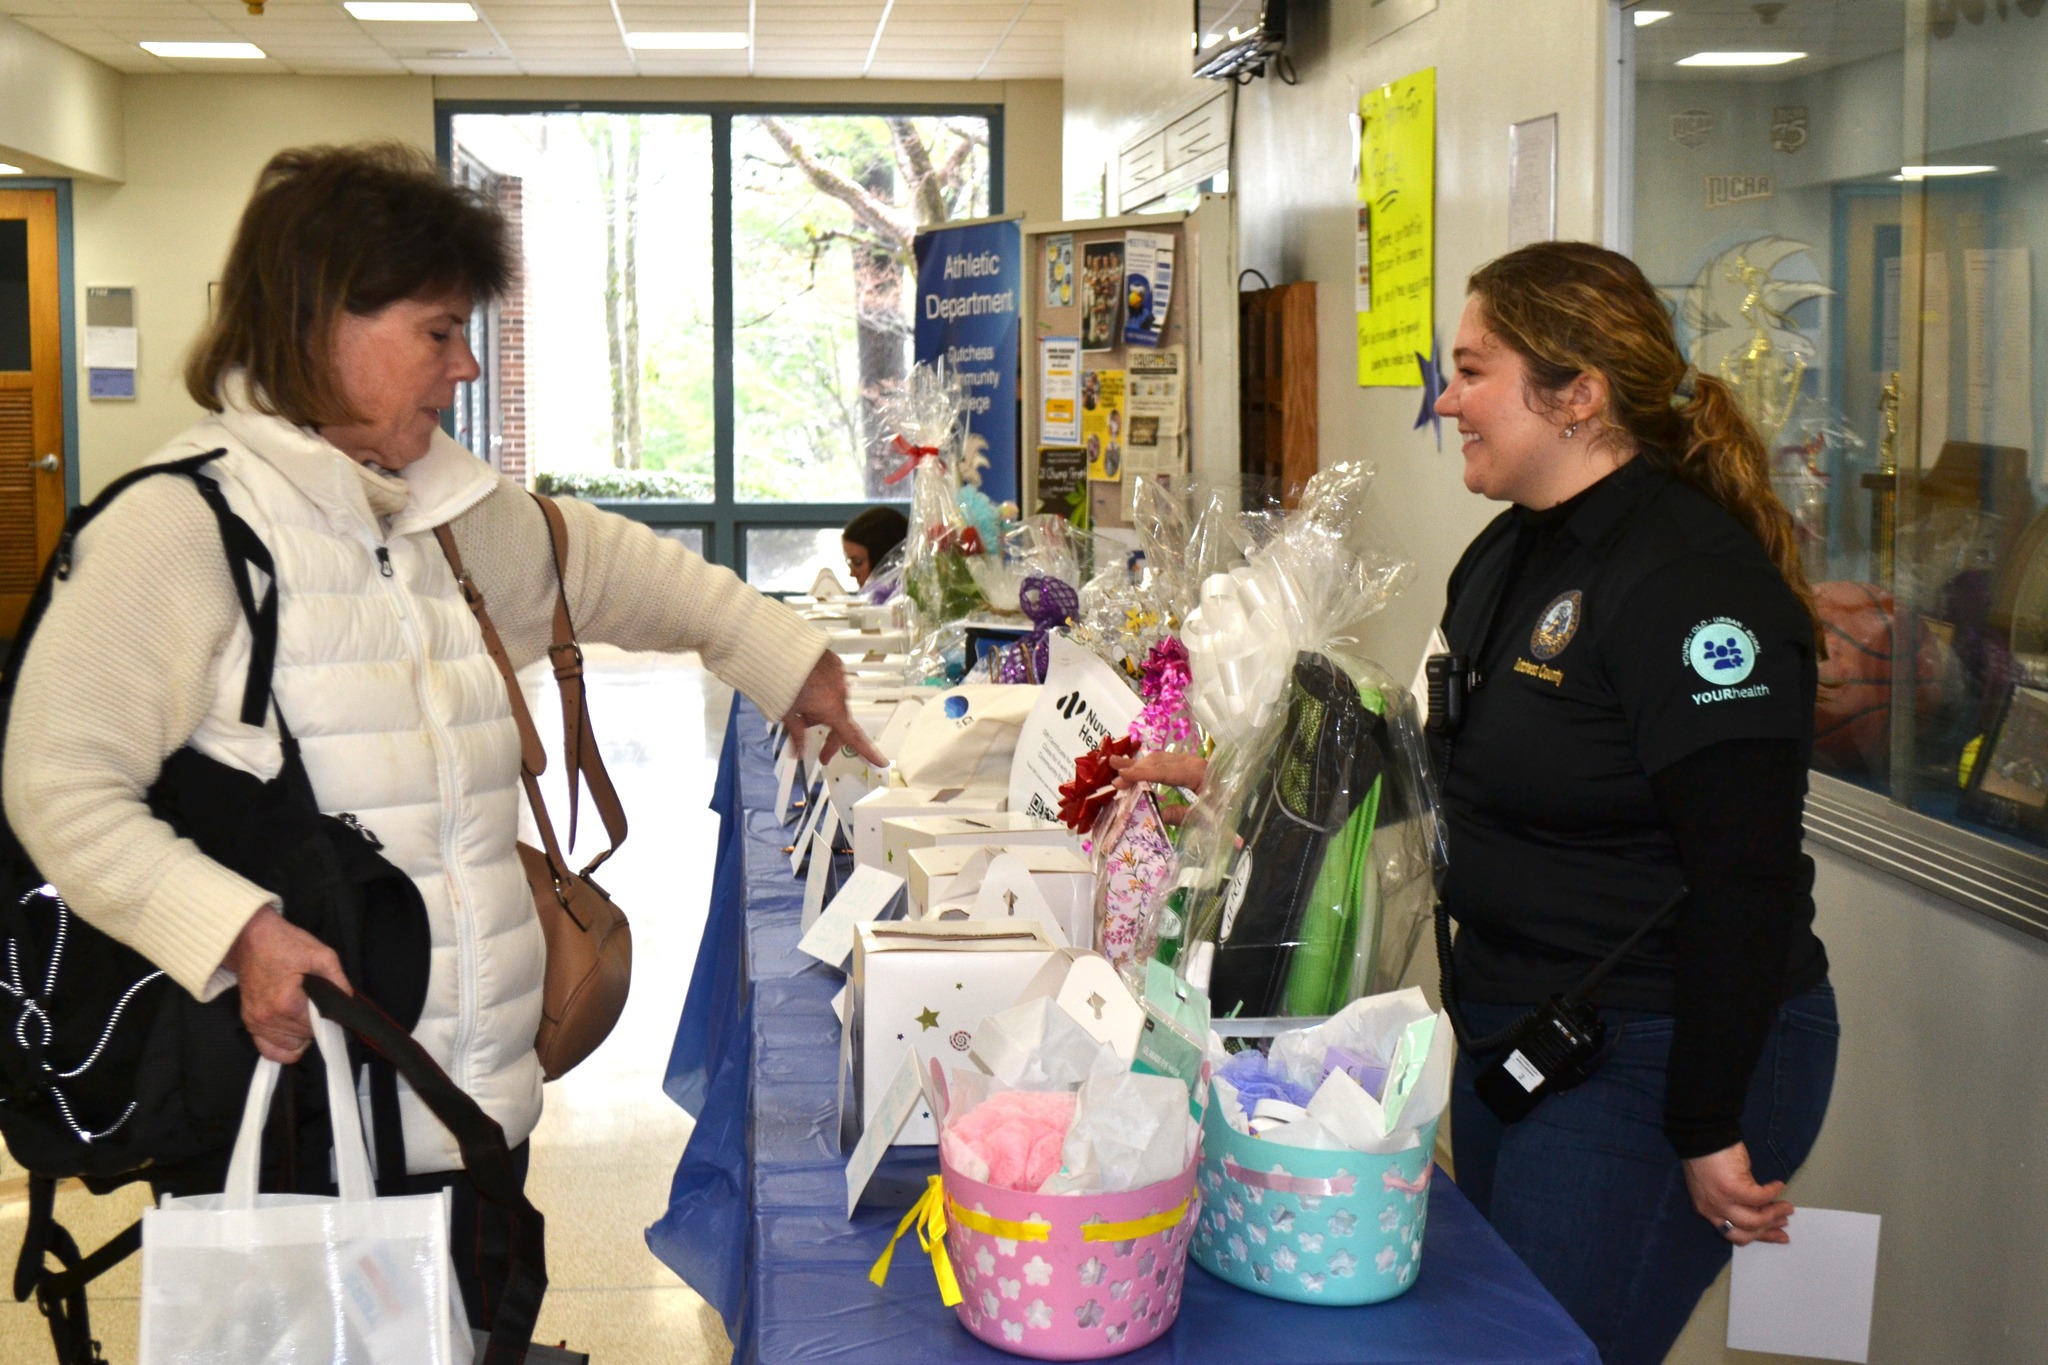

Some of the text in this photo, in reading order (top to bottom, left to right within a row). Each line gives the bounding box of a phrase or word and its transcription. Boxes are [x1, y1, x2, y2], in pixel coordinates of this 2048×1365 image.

[943, 251, 1001, 280] Athletic
[925, 289, 1014, 324] Department
[1682, 636, 1692, 667] YOUNG
[1691, 620, 1708, 634] OLD
[1712, 616, 1743, 628] URBAN
[1691, 683, 1770, 705] YOURhealth
[1079, 724, 1100, 751] Hea
[1086, 709, 1115, 741] Nuva
